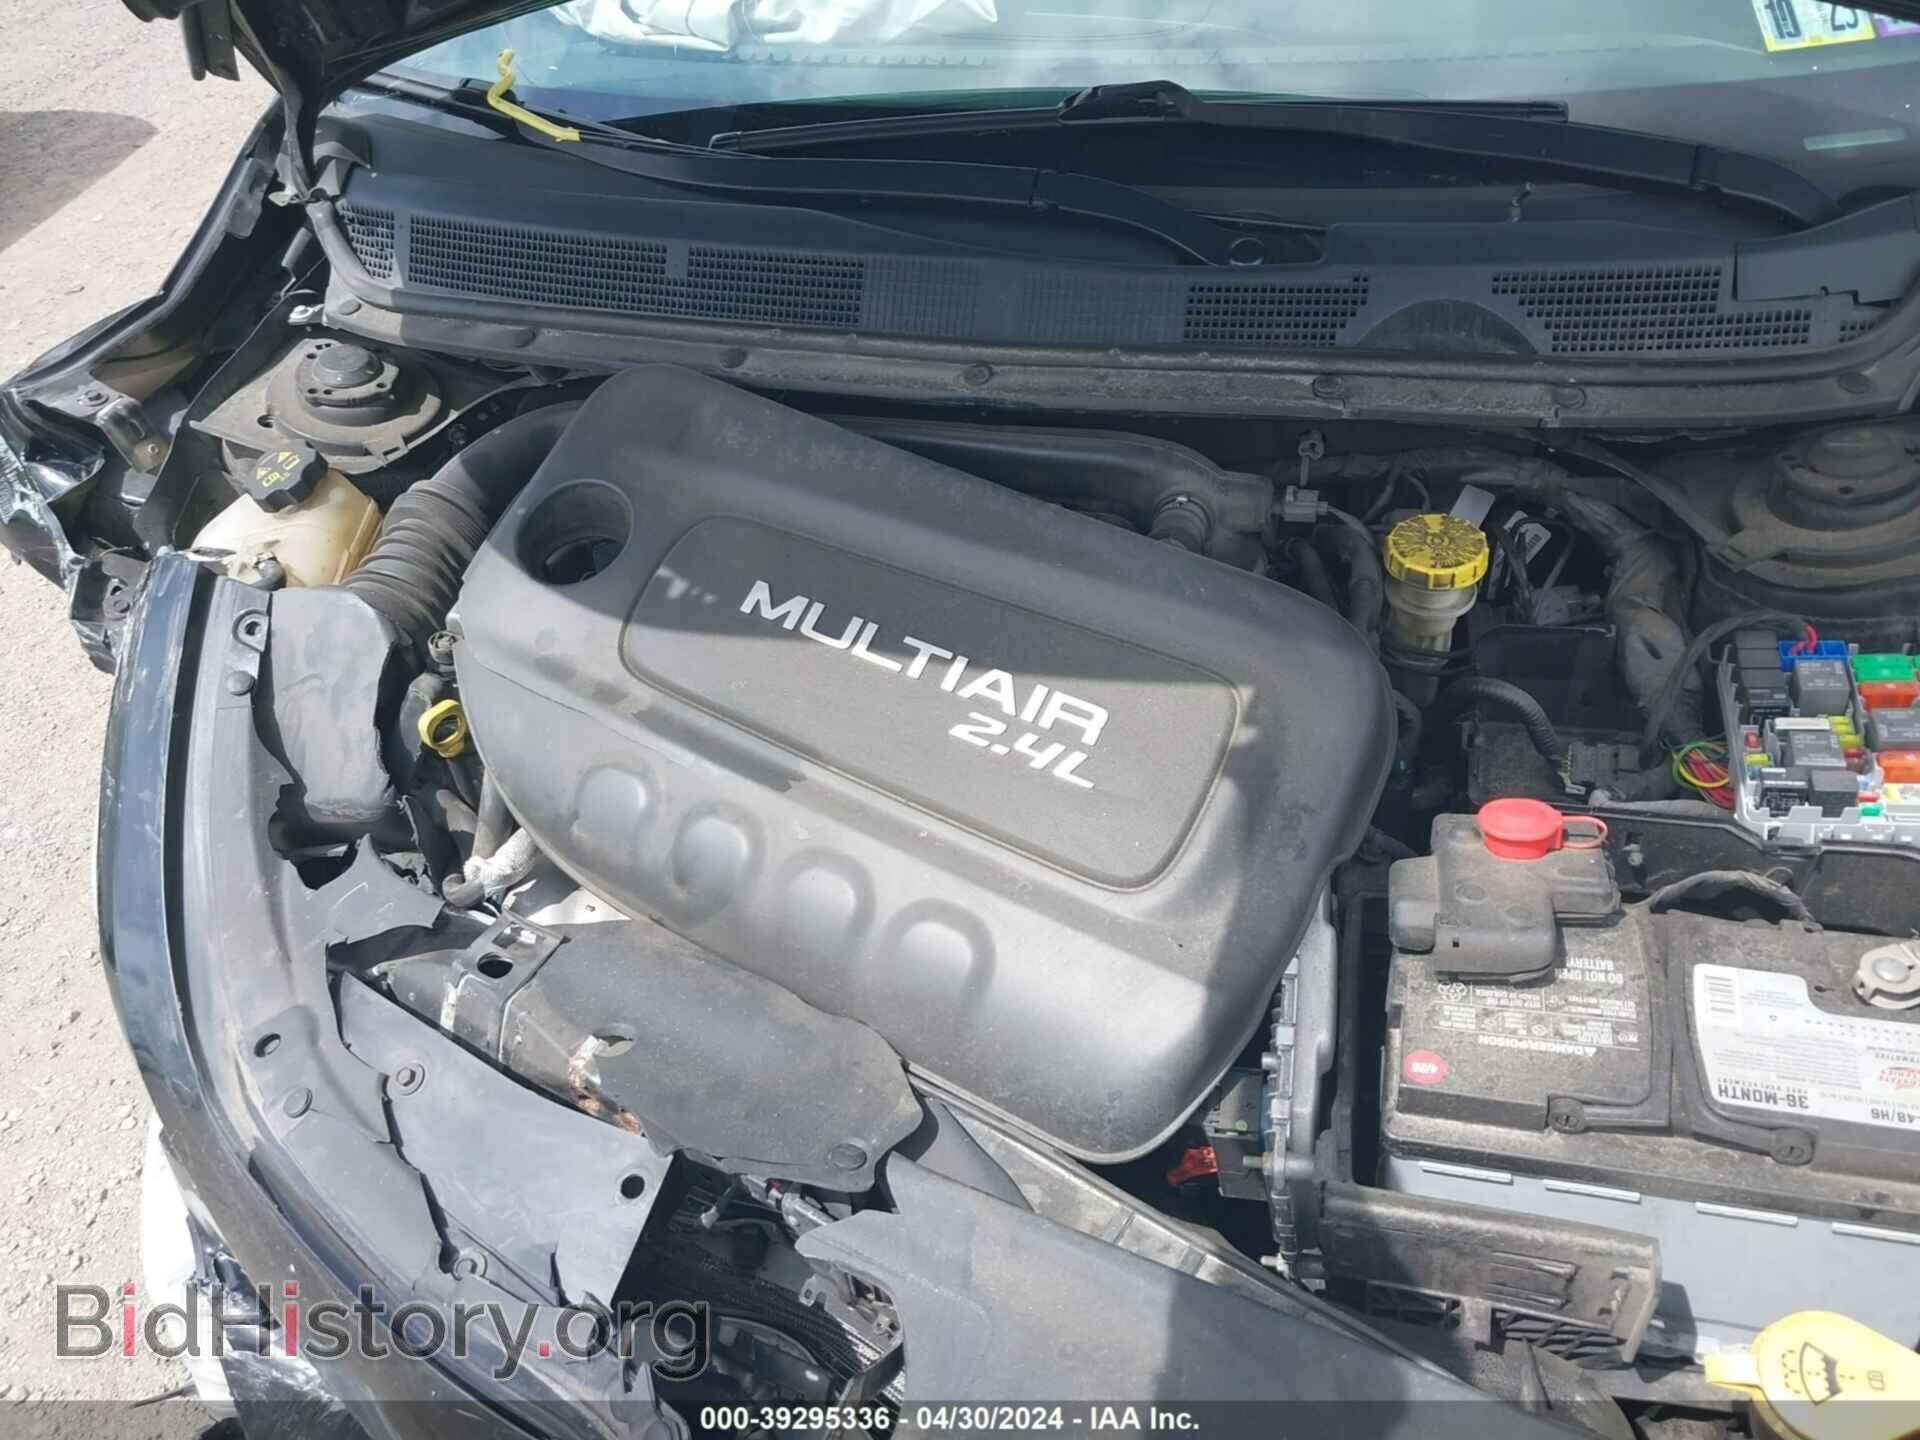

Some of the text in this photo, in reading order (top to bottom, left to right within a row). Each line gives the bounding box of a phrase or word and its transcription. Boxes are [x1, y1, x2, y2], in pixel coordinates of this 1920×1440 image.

[739, 580, 1109, 746] MULTIAIR
[948, 711, 1095, 788] 2.4L
[1717, 1083, 1810, 1109] 36-MONTH
